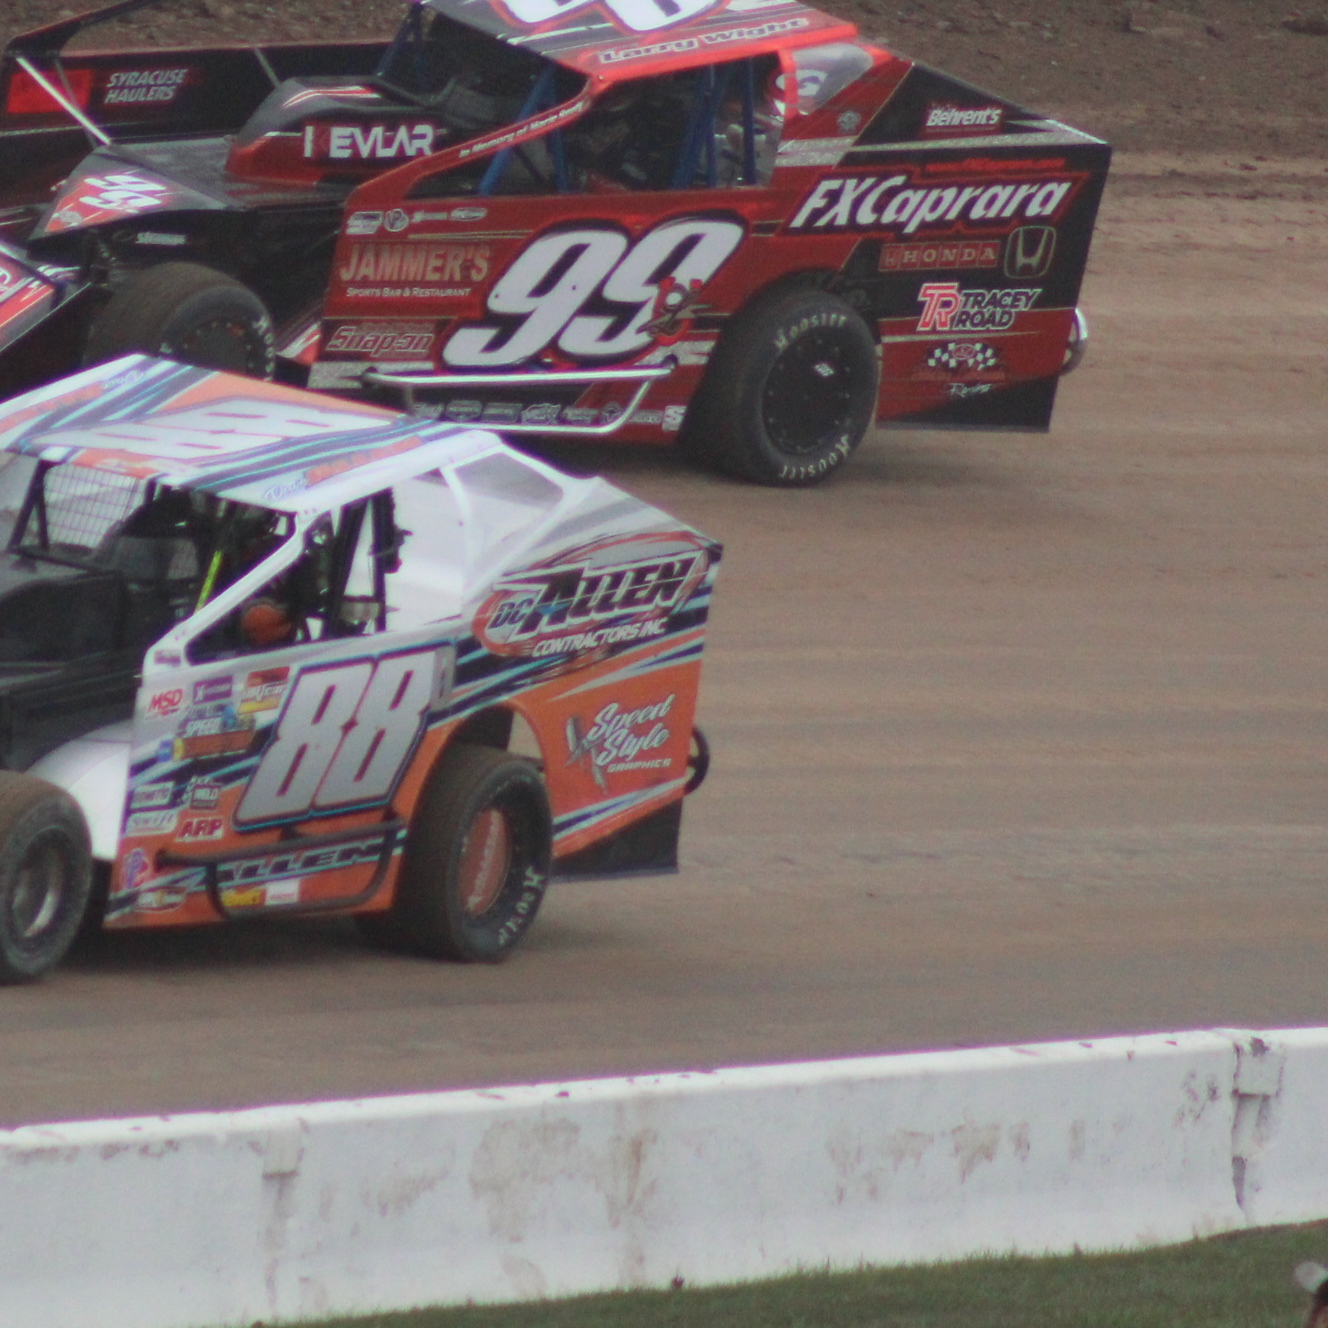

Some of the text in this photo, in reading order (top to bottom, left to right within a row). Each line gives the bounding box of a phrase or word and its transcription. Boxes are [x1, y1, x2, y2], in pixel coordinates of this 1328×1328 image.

[600, 18, 809, 63] Larry Wight
[106, 69, 188, 87] SYRACUSE
[104, 86, 177, 103] HAULERS
[926, 106, 1002, 127] Behrent's
[339, 243, 491, 282] JAMMER'S
[902, 246, 996, 263] HONDA
[442, 220, 744, 366] 99
[960, 288, 1043, 312] TRACEY
[952, 309, 1015, 330] ROAD
[325, 326, 434, 358] Snap-on
[487, 550, 704, 640] DC ALLEN
[532, 617, 668, 657] CONTRACTORS INC
[149, 689, 183, 714] MSD
[587, 693, 675, 742] Speed
[234, 651, 436, 821] 88
[596, 723, 670, 765] Style
[178, 819, 221, 840] ARP
